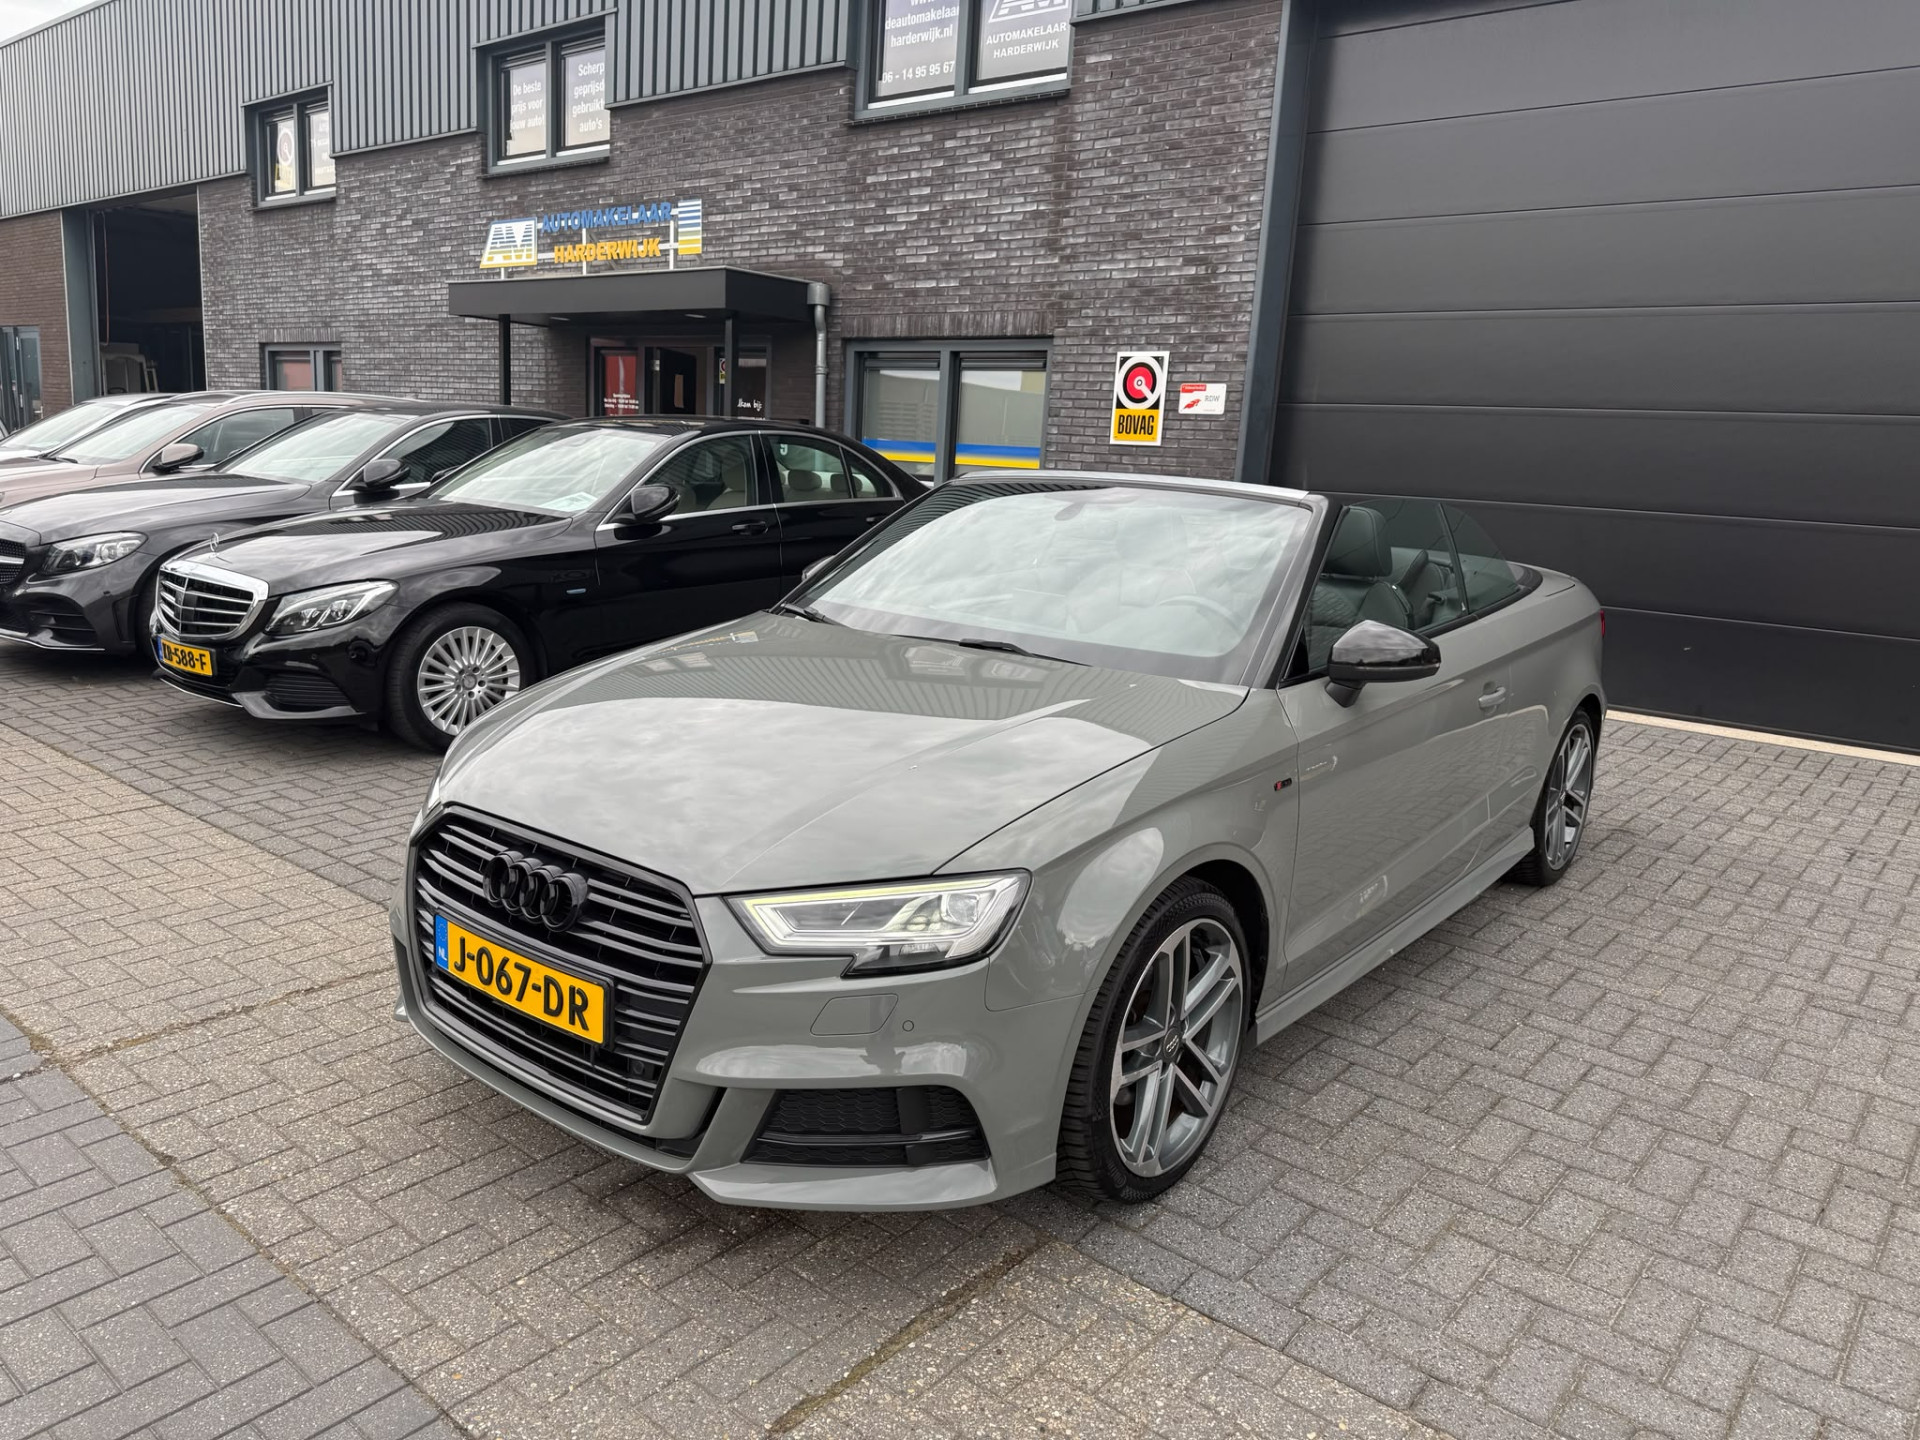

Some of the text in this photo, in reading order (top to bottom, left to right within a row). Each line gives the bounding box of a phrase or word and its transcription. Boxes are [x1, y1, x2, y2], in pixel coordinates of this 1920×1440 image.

[885, 6, 959, 30] deautomakelaar
[890, 24, 953, 47] harderwijk.nl
[986, 22, 1067, 45] AUTOMAKELAAR
[993, 39, 1059, 59] HARDERWIJK
[578, 62, 605, 76] Scherp
[882, 71, 893, 83] 06
[902, 68, 913, 80] 14
[915, 66, 927, 79] 95
[929, 63, 941, 76] 95
[943, 61, 955, 74] 67
[513, 81, 541, 96] De beste
[511, 99, 543, 115] prijs voor
[579, 118, 603, 132] auto's
[542, 201, 672, 233] AUTOMAKELAAR
[554, 237, 661, 264] HARDERWIJK
[1117, 414, 1155, 435] BOVAG
[438, 946, 448, 961] NL
[454, 936, 590, 1031] J-067-DR
